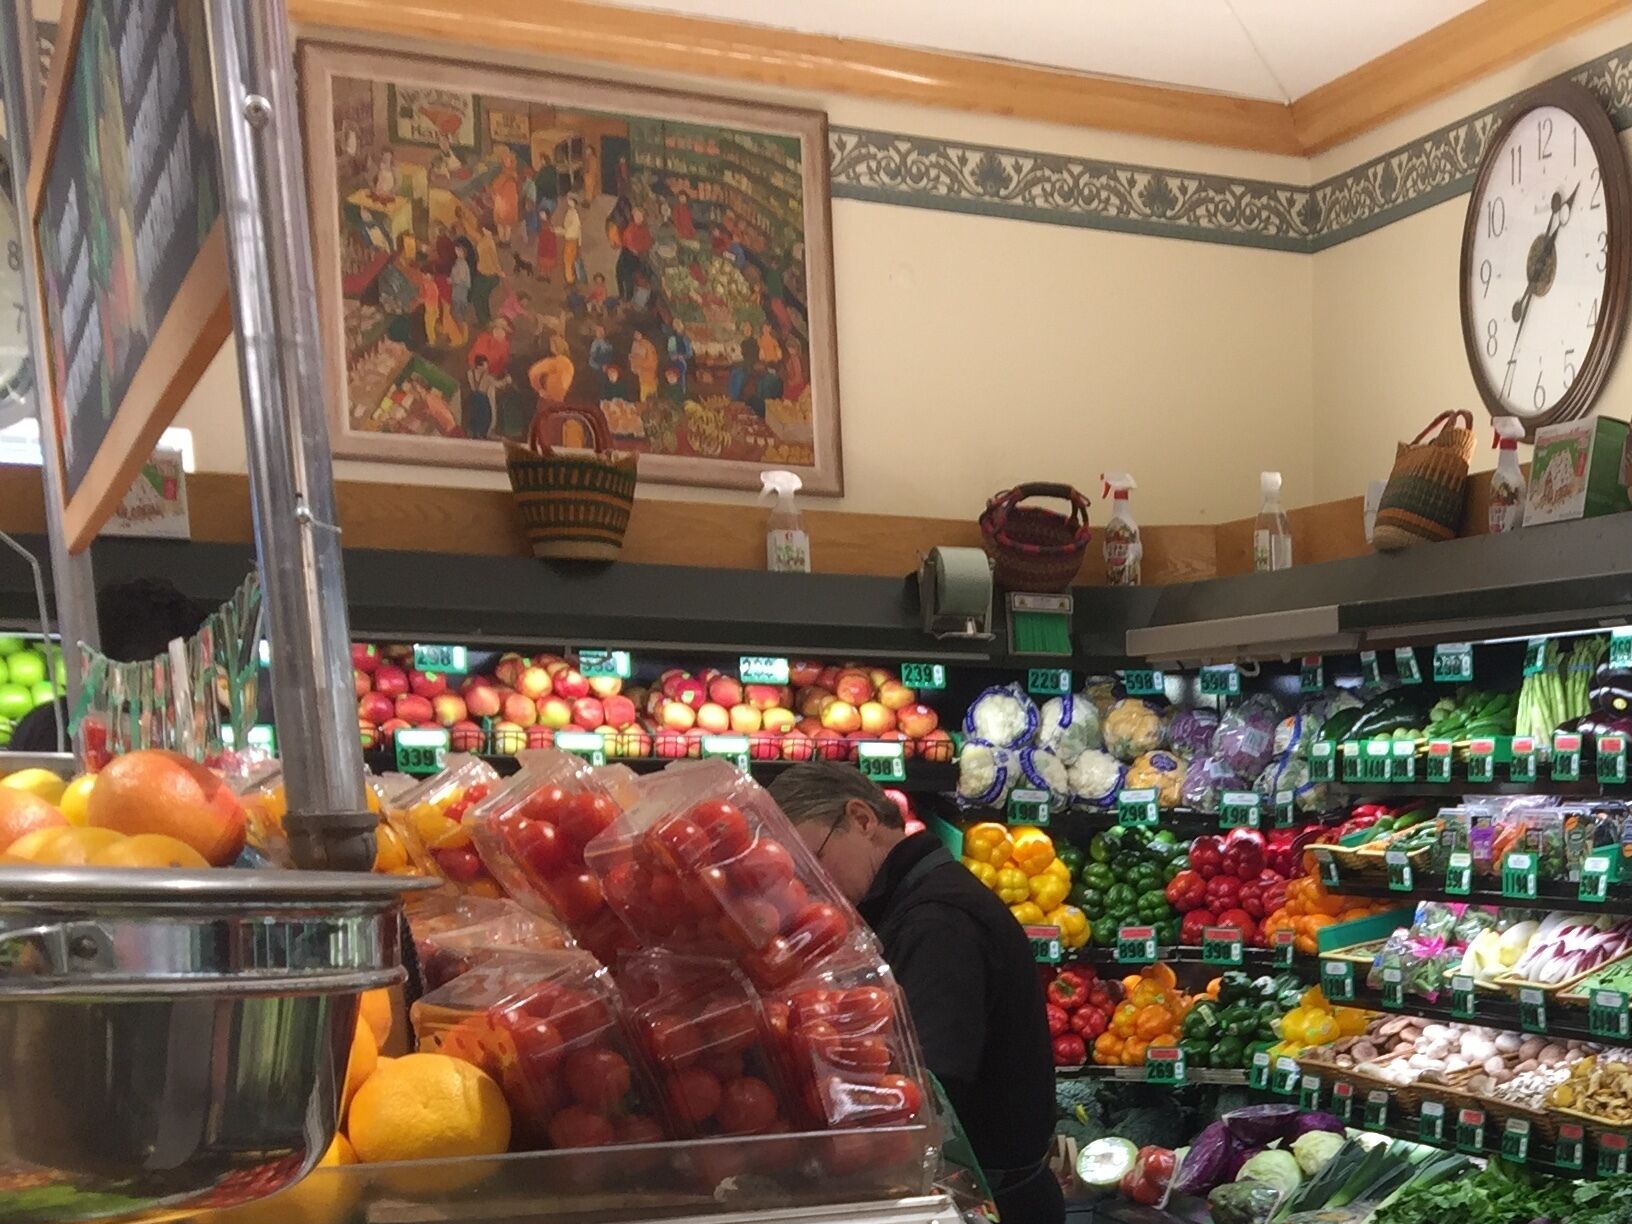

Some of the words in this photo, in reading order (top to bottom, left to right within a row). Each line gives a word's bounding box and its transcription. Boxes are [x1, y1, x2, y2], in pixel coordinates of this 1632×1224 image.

[1538, 118, 1553, 160] 12
[1510, 144, 1522, 186] 11
[1590, 166, 1601, 211] 2
[1487, 196, 1506, 238] 10
[1596, 230, 1608, 273] 3
[1480, 259, 1492, 299] 9
[1586, 297, 1599, 329] 4
[1486, 318, 1498, 358] 8
[1506, 358, 1518, 399] 7
[1563, 349, 1576, 389] 5
[1533, 370, 1547, 411] 6
[904, 664, 933, 684] 239
[1030, 670, 1061, 690] 229
[863, 757, 891, 776] 398
